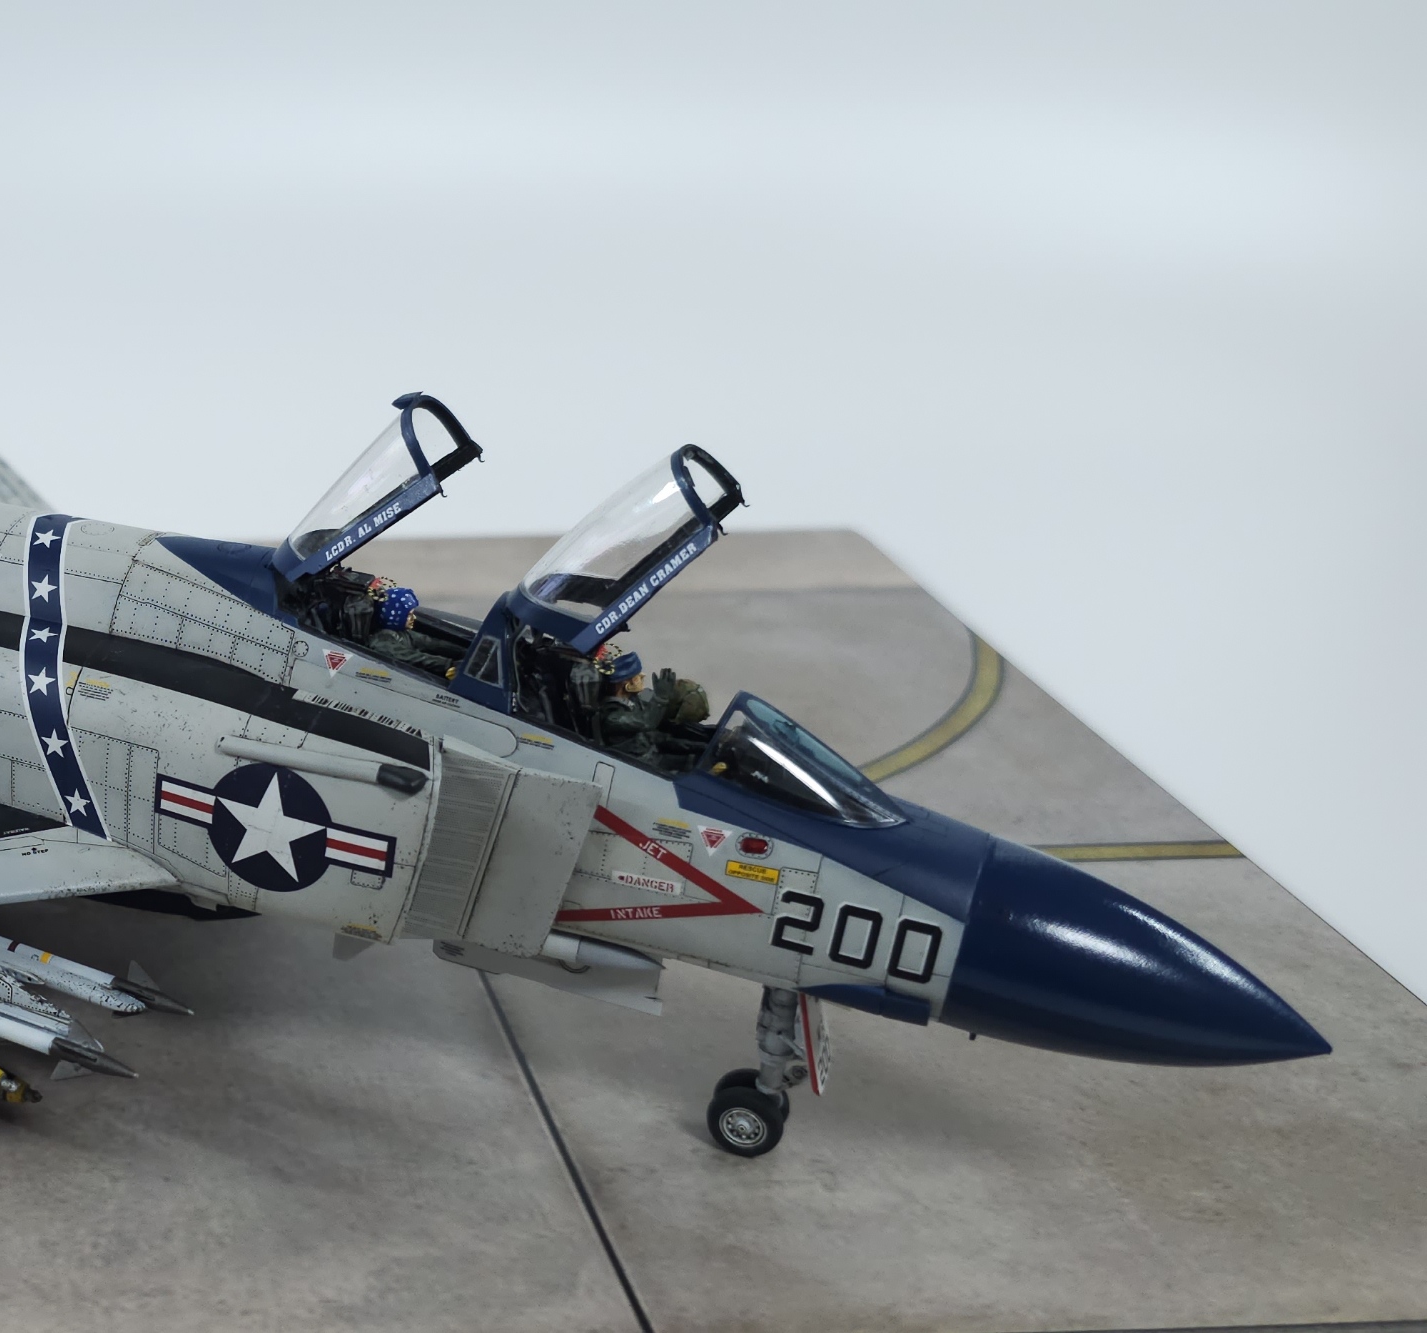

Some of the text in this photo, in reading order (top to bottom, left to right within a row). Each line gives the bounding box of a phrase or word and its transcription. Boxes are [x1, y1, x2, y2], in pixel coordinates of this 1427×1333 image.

[325, 502, 402, 561] LCDR. AL MISE
[649, 542, 697, 587] CRAMER
[638, 840, 668, 859] JET
[625, 875, 674, 893] DANGER
[610, 907, 662, 919] INTAKE
[769, 889, 943, 984] 200
